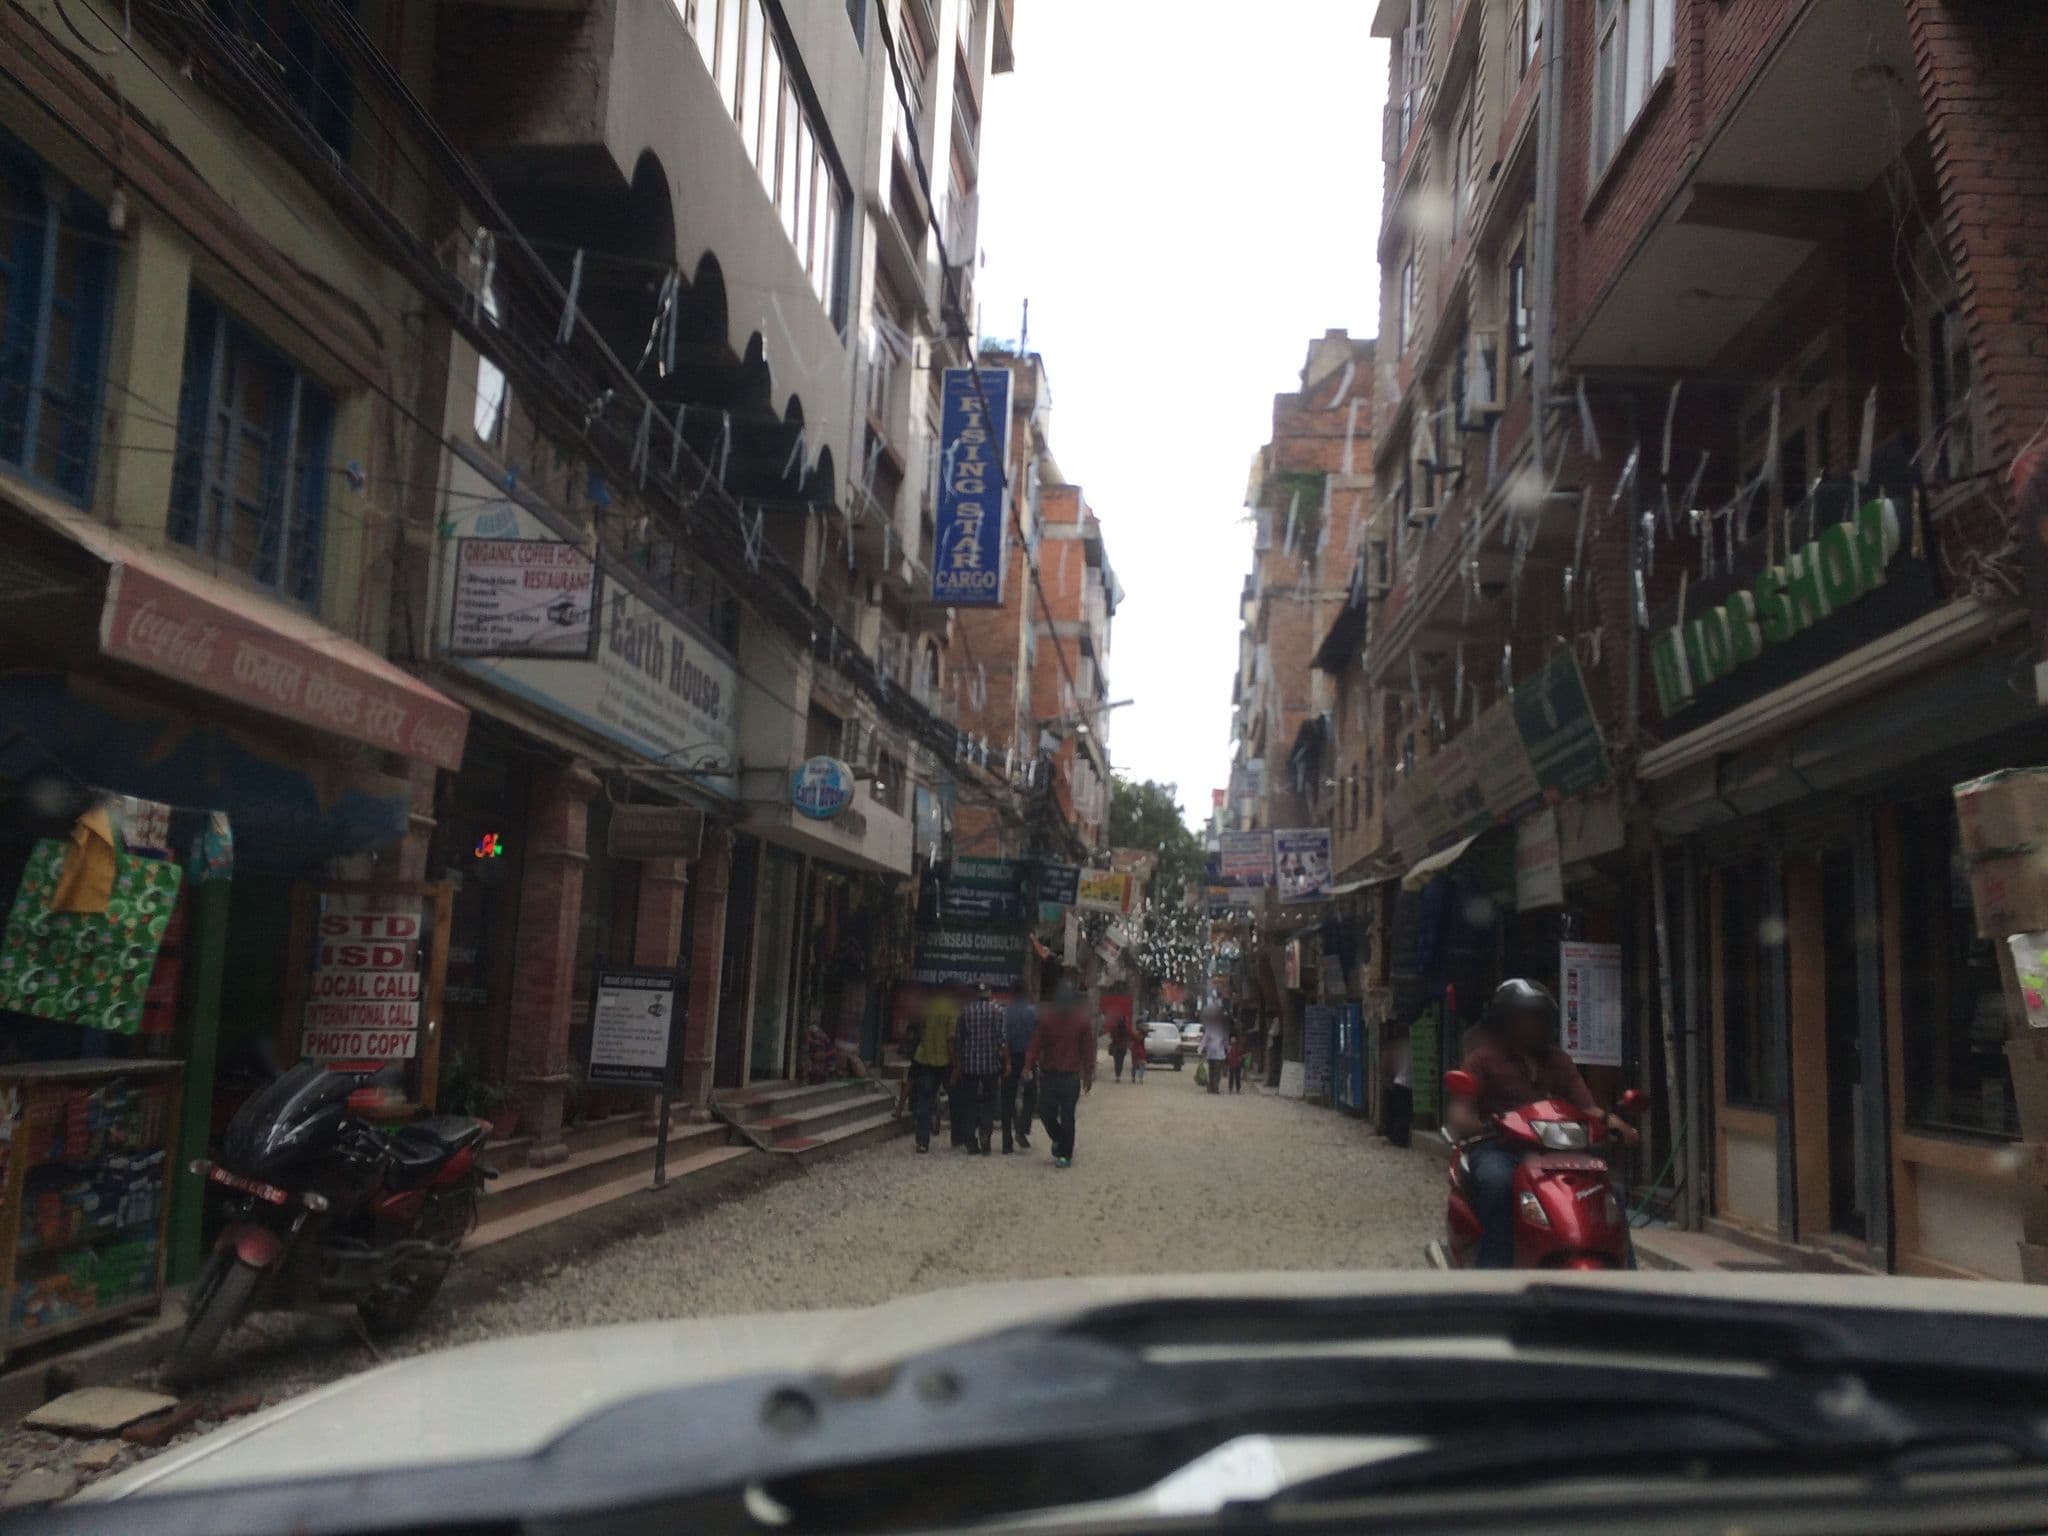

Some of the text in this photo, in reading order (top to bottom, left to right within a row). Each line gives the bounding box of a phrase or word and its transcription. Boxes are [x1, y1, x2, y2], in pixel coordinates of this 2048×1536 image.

[952, 502, 984, 568] STAR
[463, 542, 514, 563] ORGANIC
[517, 543, 556, 563] COFFEE
[522, 570, 591, 591] RESTAURANT
[936, 571, 996, 588] CARGO
[609, 588, 665, 684] Earth
[669, 634, 721, 721] House
[320, 915, 417, 937] STD
[321, 945, 403, 967] ISD
[312, 975, 418, 997] LOCAL CALL
[308, 1003, 414, 1026] INTERNATIONAL CALL
[306, 1034, 412, 1056] PHOTO COPY
